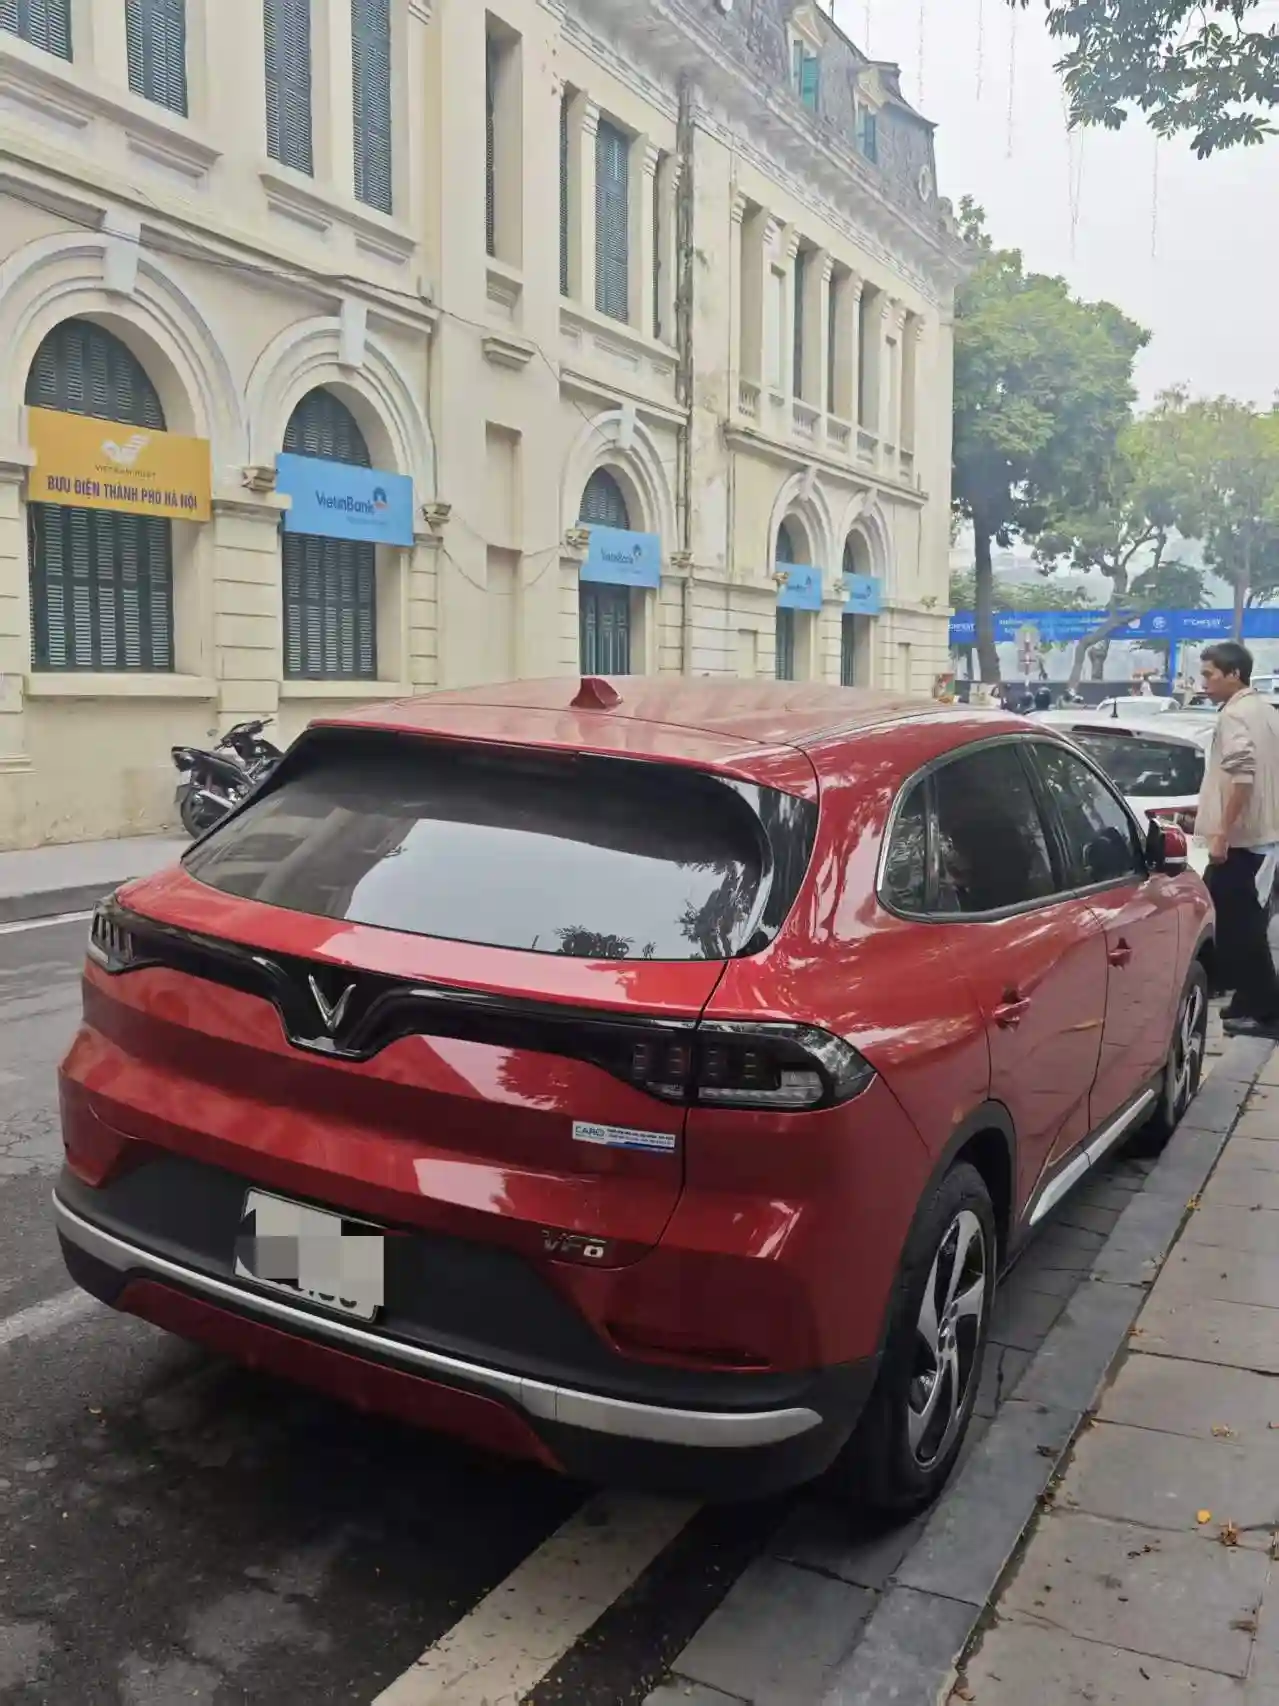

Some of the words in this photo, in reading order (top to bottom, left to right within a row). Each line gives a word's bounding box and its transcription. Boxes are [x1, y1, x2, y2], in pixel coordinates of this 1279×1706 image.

[103, 481, 138, 502] THÀNH
[164, 488, 178, 508] HÀ
[180, 491, 198, 512] NỘI
[315, 489, 375, 515] VietinBank
